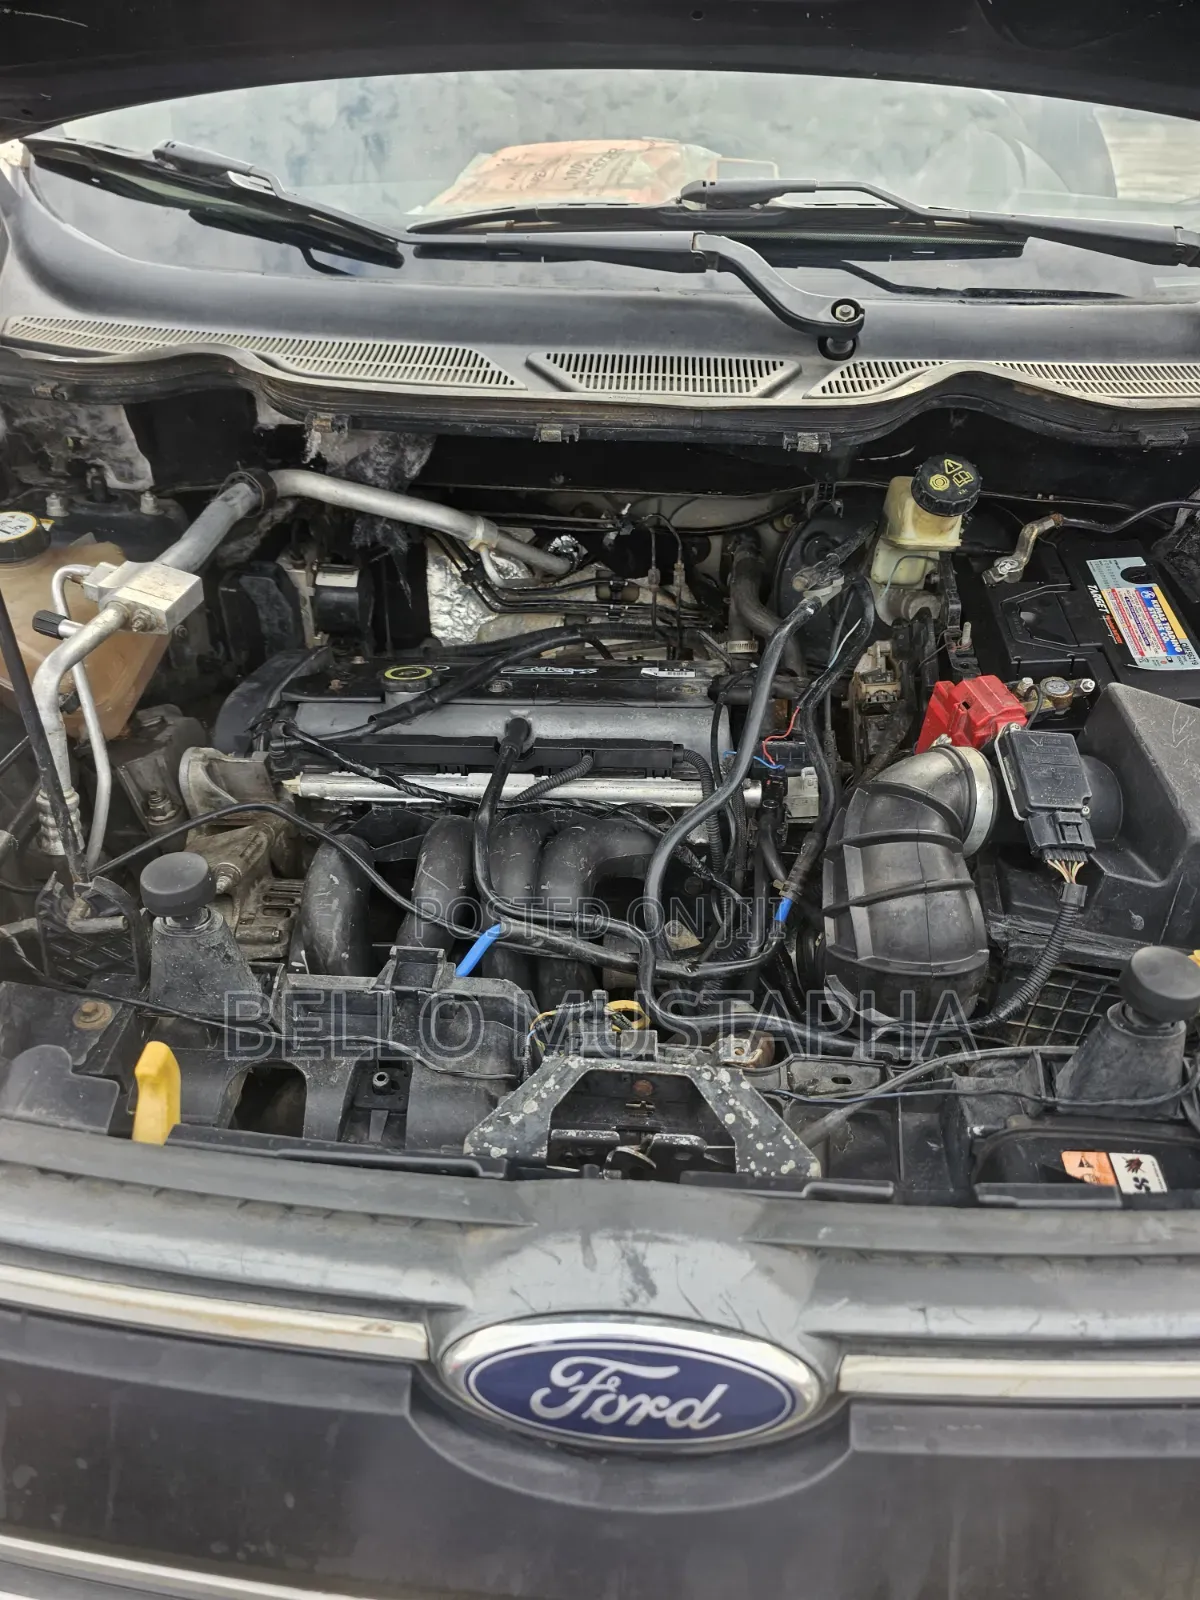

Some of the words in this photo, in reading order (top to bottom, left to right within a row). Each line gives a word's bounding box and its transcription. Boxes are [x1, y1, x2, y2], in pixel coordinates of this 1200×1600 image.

[1087, 584, 1110, 614] TARGET
[1148, 607, 1165, 631] STORES
[1163, 622, 1183, 653] TRADING
[529, 1355, 731, 1431] Ford
